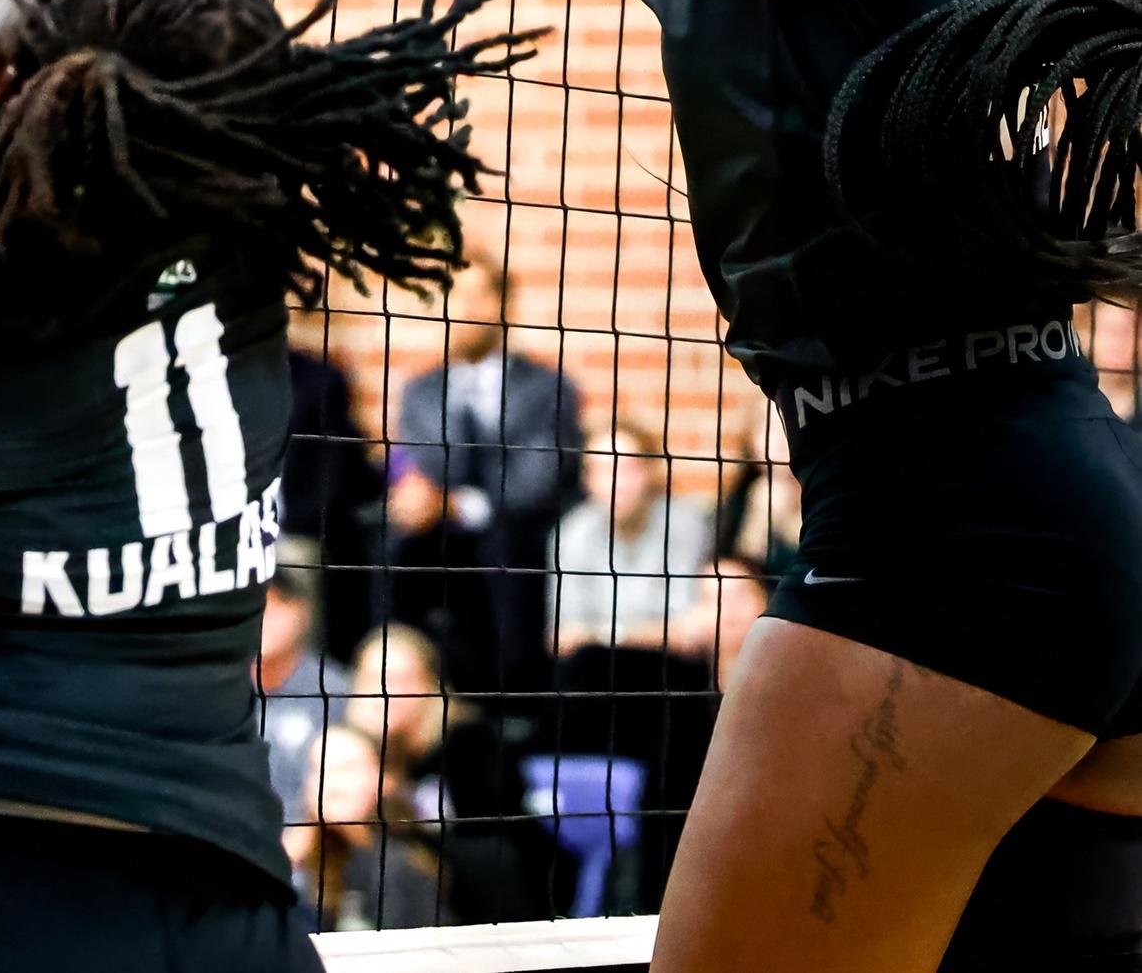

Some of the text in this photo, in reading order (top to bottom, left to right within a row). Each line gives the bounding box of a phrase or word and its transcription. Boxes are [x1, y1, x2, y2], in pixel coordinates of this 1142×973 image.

[114, 303, 248, 538] 11
[794, 338, 950, 429] NIKE
[965, 320, 1067, 370] PRO
